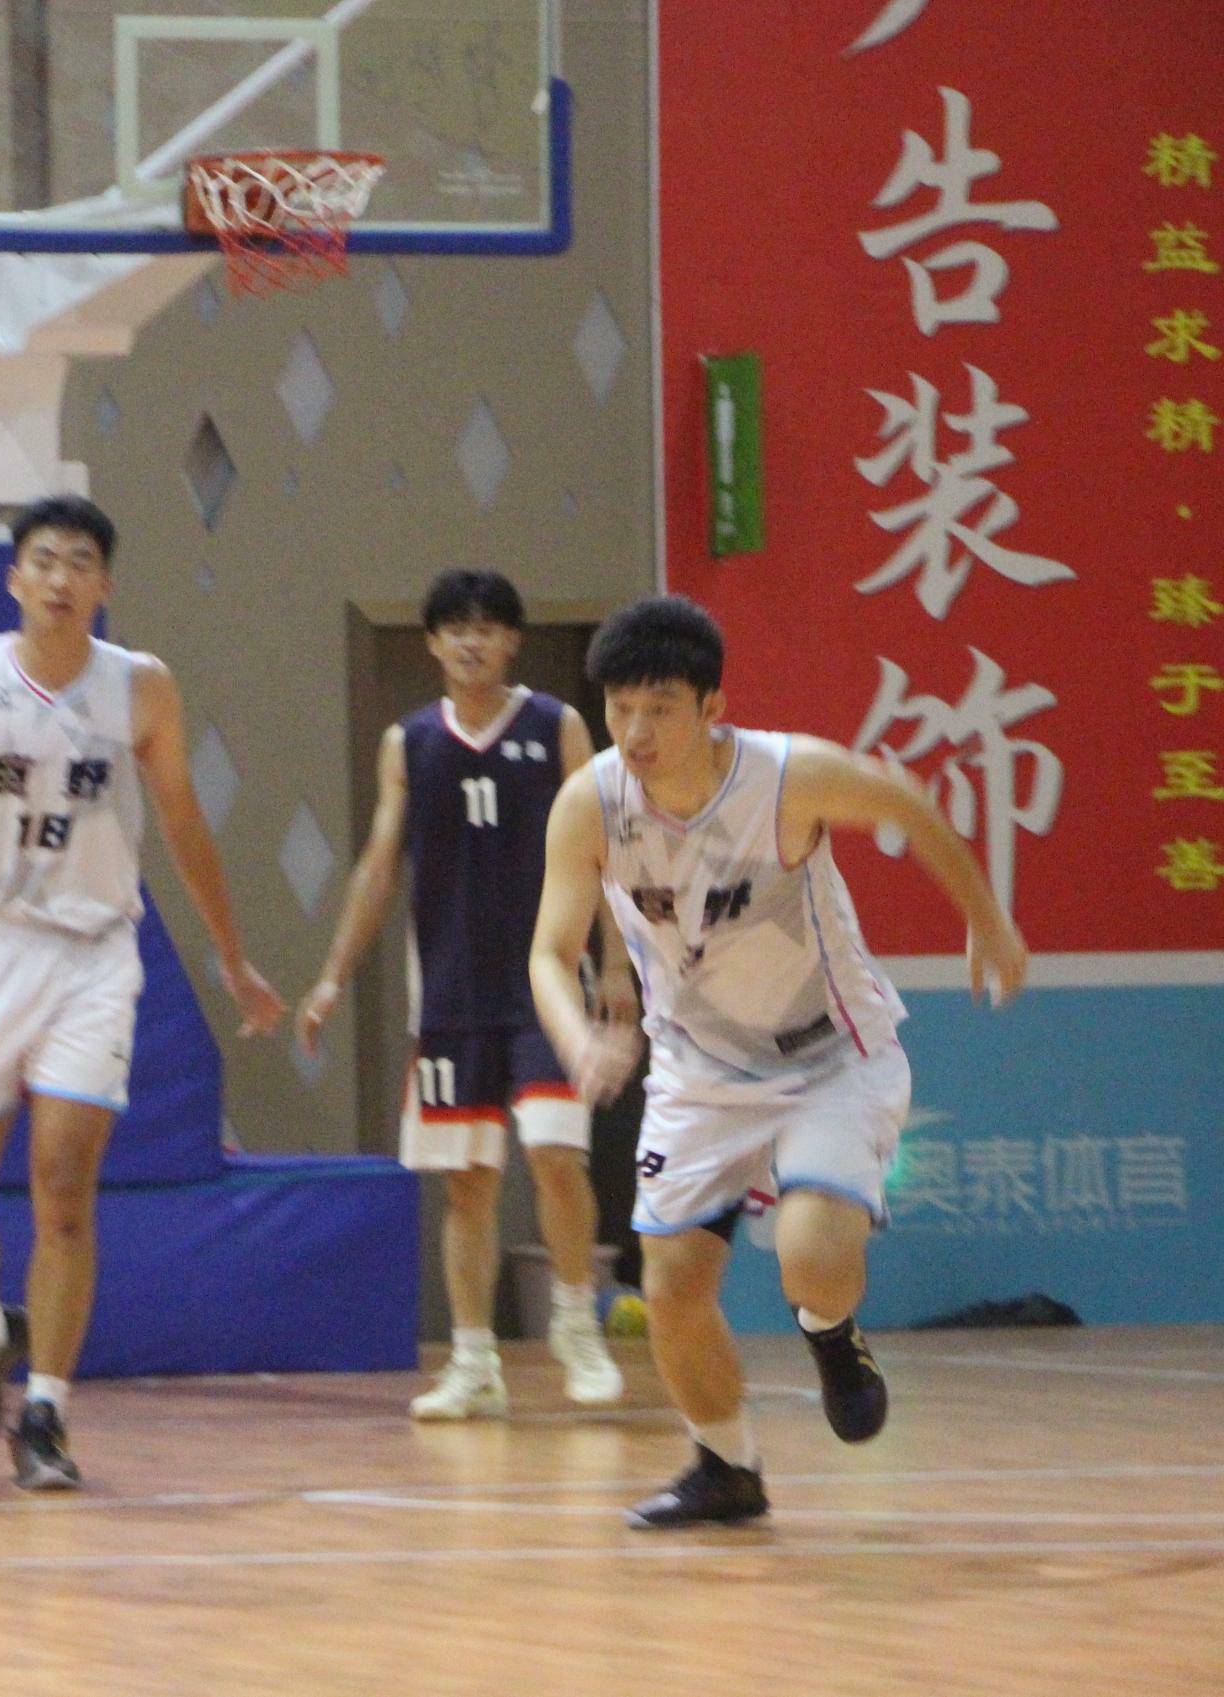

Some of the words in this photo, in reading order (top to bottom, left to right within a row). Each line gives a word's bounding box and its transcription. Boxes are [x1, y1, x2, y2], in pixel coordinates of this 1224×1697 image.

[842, 0, 1076, 925] 告装饰
[460, 776, 498, 827] 11
[417, 1056, 456, 1107] 11
